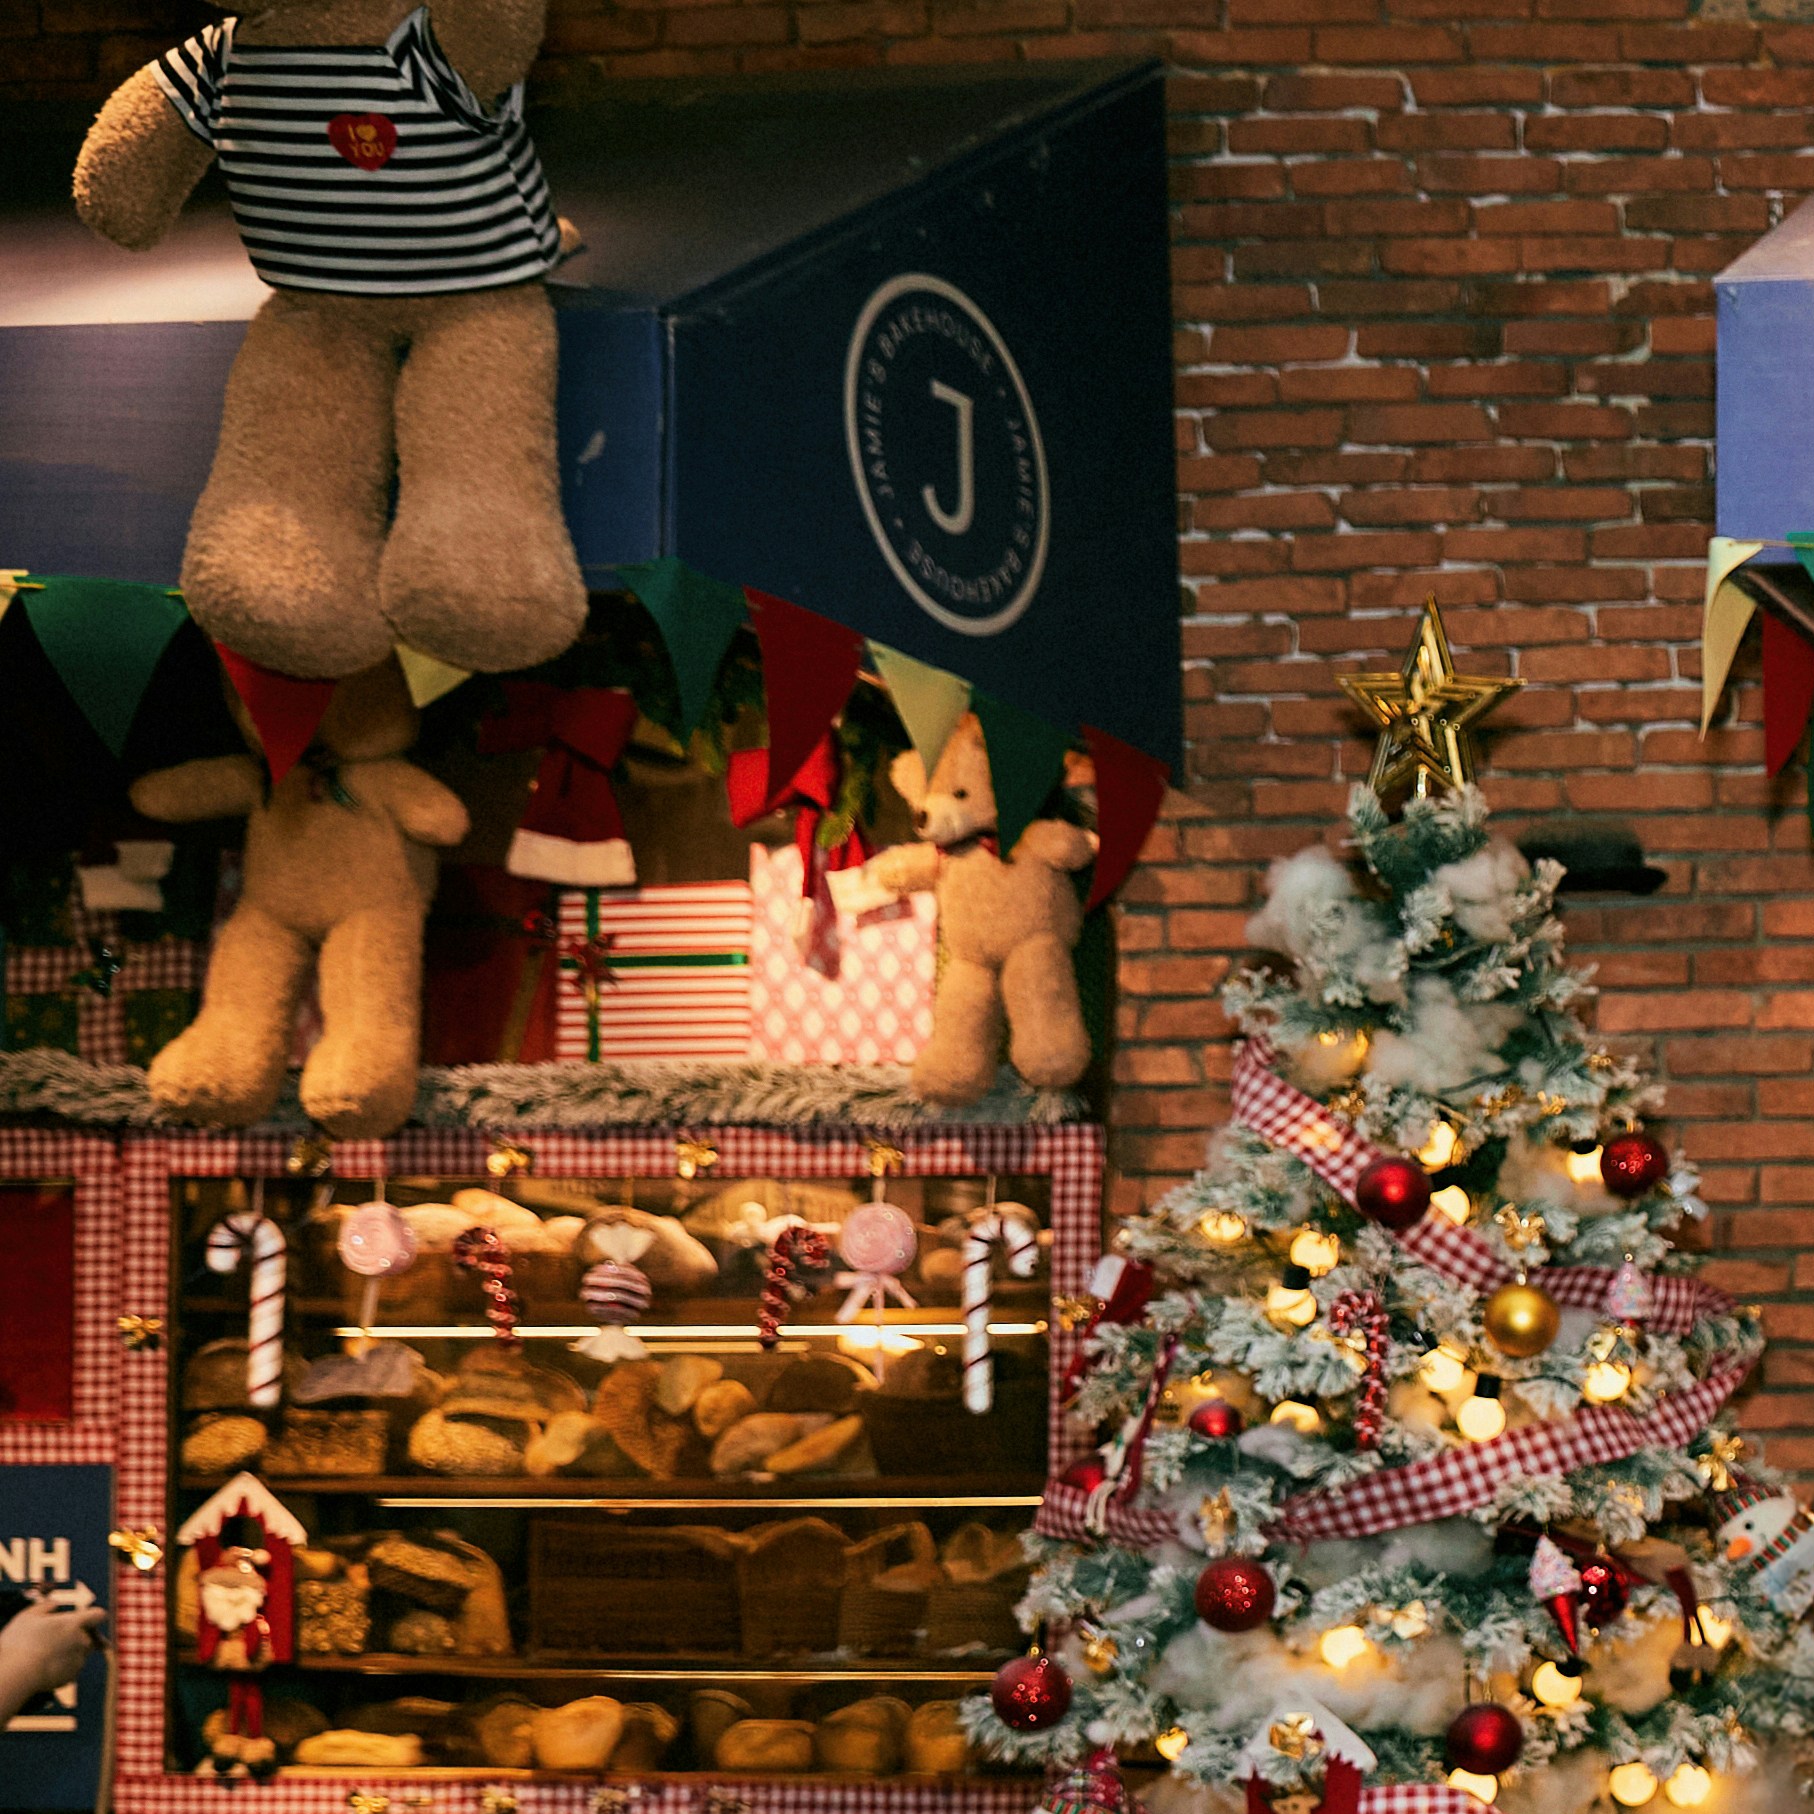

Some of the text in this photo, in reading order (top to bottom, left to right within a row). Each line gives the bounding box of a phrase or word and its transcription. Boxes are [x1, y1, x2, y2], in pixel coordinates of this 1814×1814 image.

[347, 123, 356, 142] I
[349, 141, 385, 158] YOU
[921, 377, 975, 536] J
